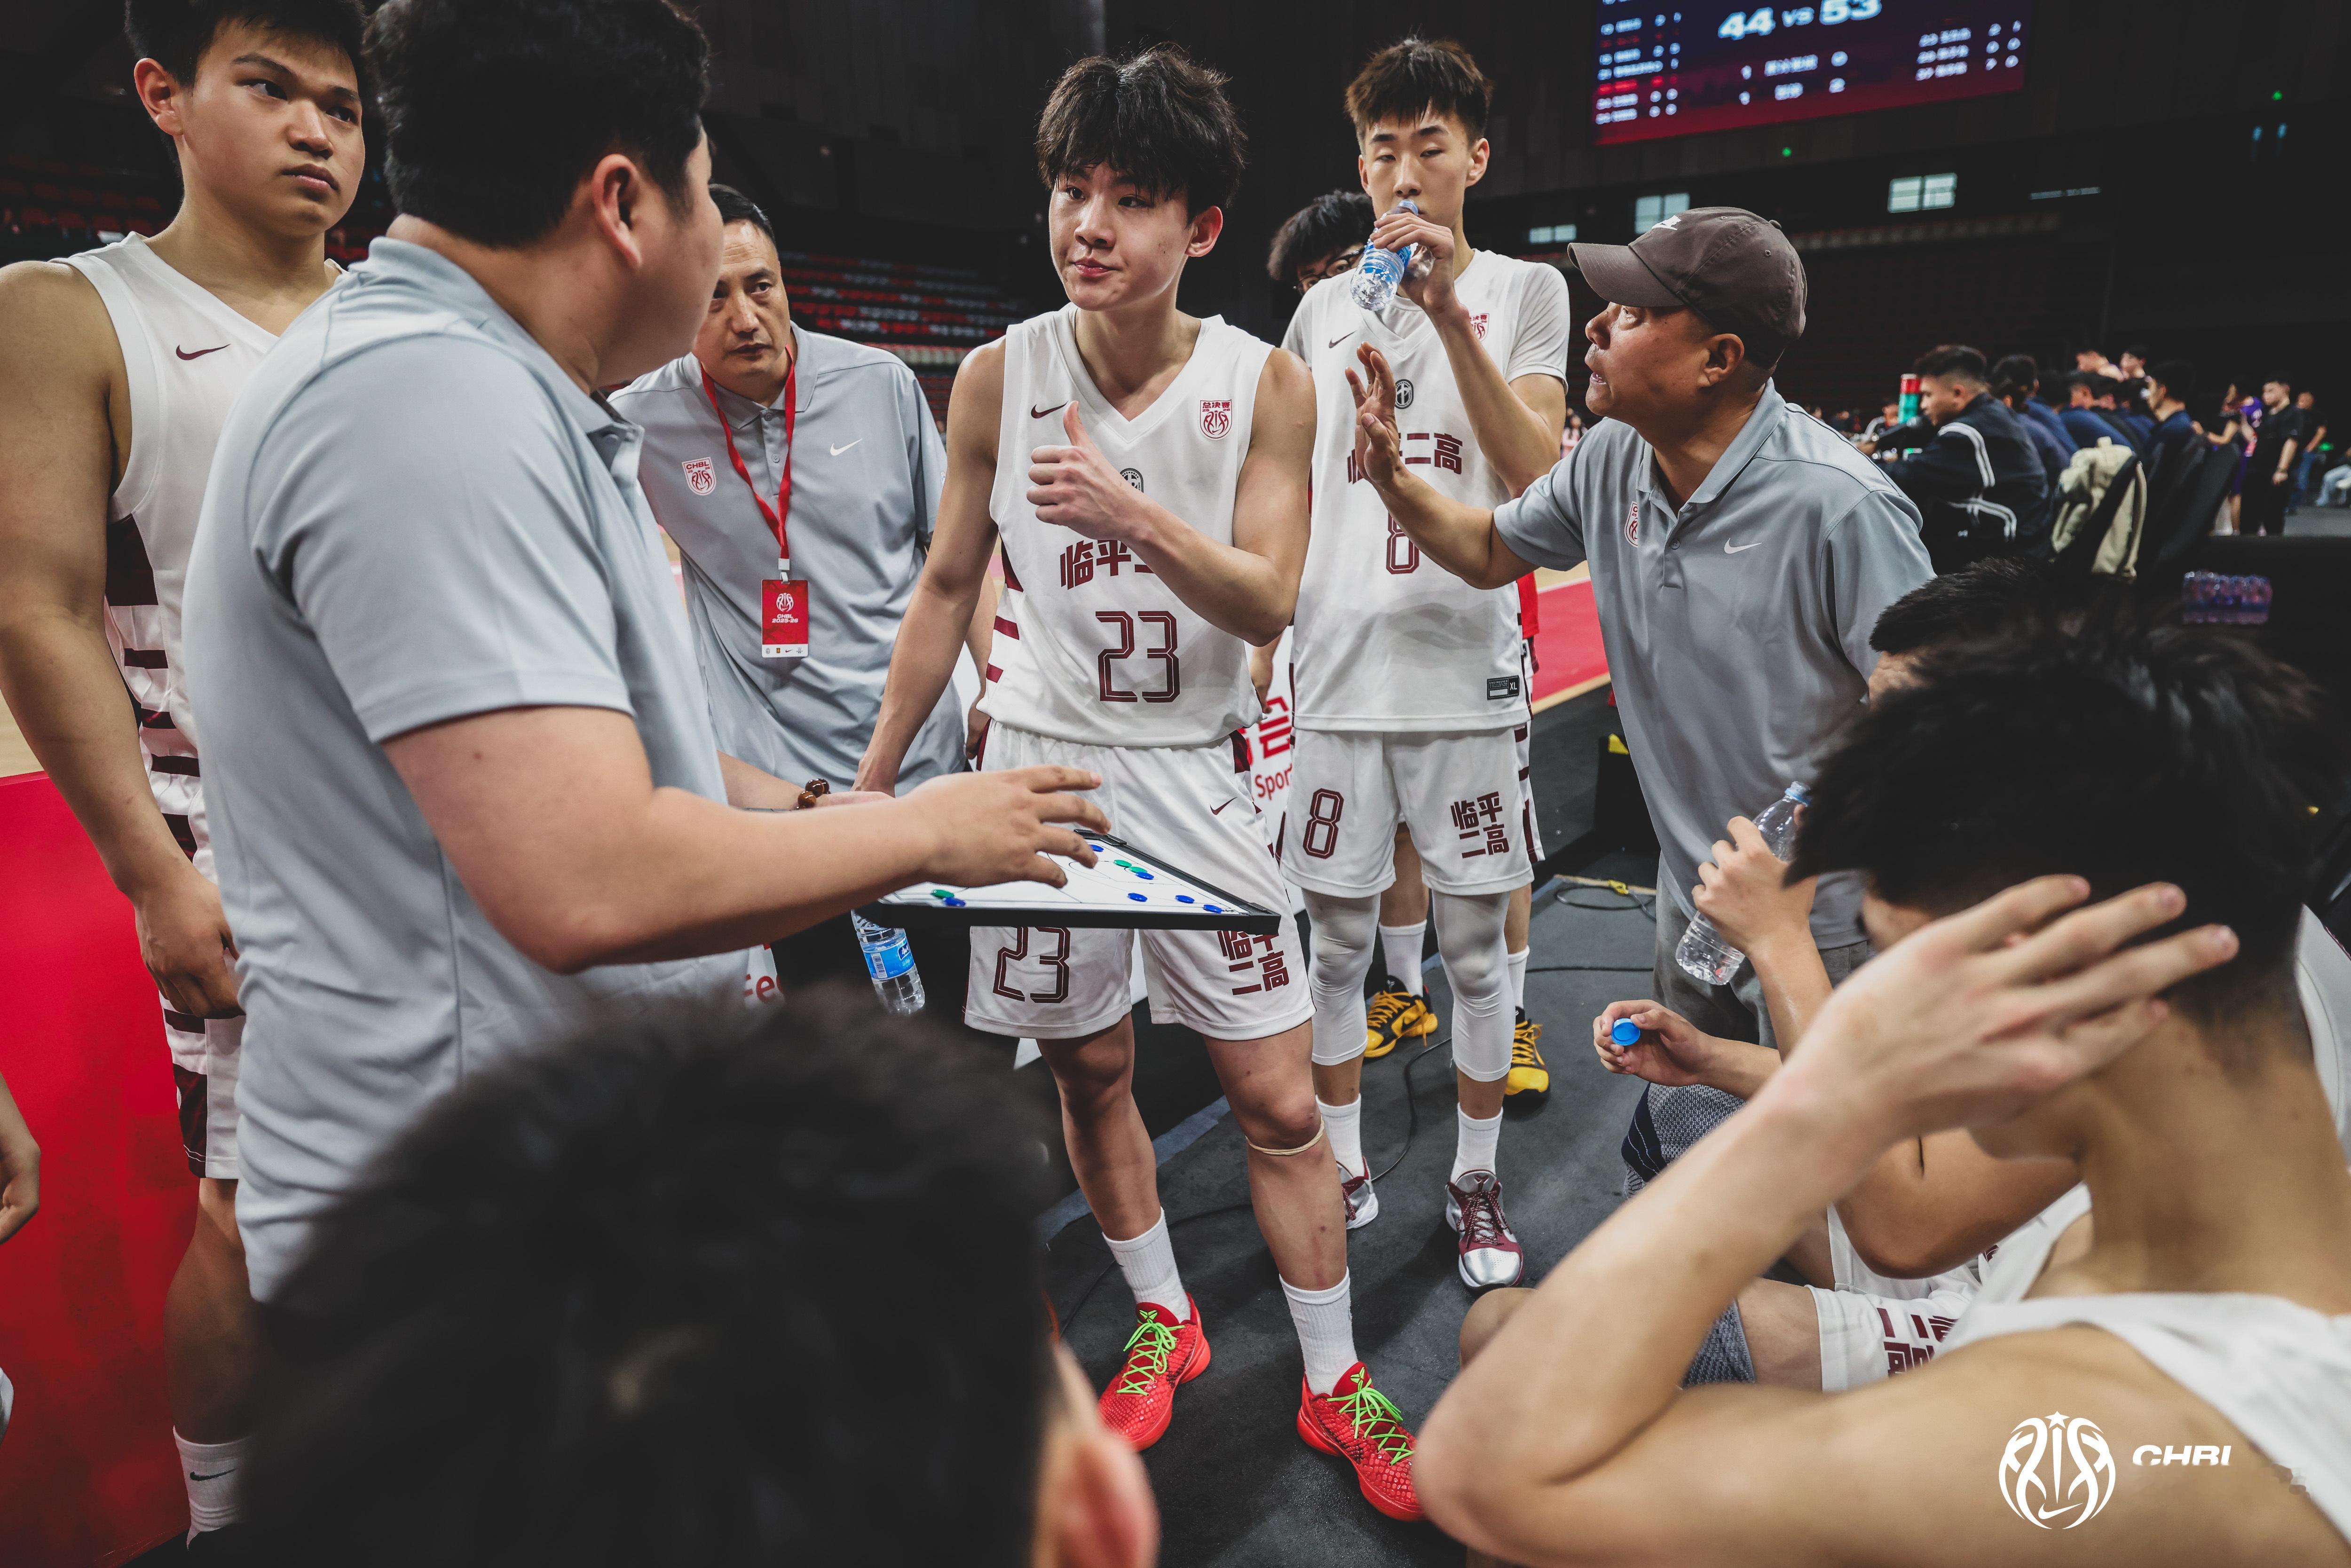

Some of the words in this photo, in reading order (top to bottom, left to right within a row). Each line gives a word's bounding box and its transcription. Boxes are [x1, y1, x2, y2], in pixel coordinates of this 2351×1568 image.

[1718, 7, 1776, 40] 44
[1819, 0, 1882, 25] 53
[686, 461, 709, 470] CHBL
[1060, 540, 1155, 590] 临平
[1095, 610, 1180, 703] 23
[1510, 681, 1517, 691] XL
[1255, 763, 1293, 800] Spor
[1303, 788, 1344, 859] 8
[1451, 791, 1503, 830] 临平
[993, 926, 1071, 1003] 23
